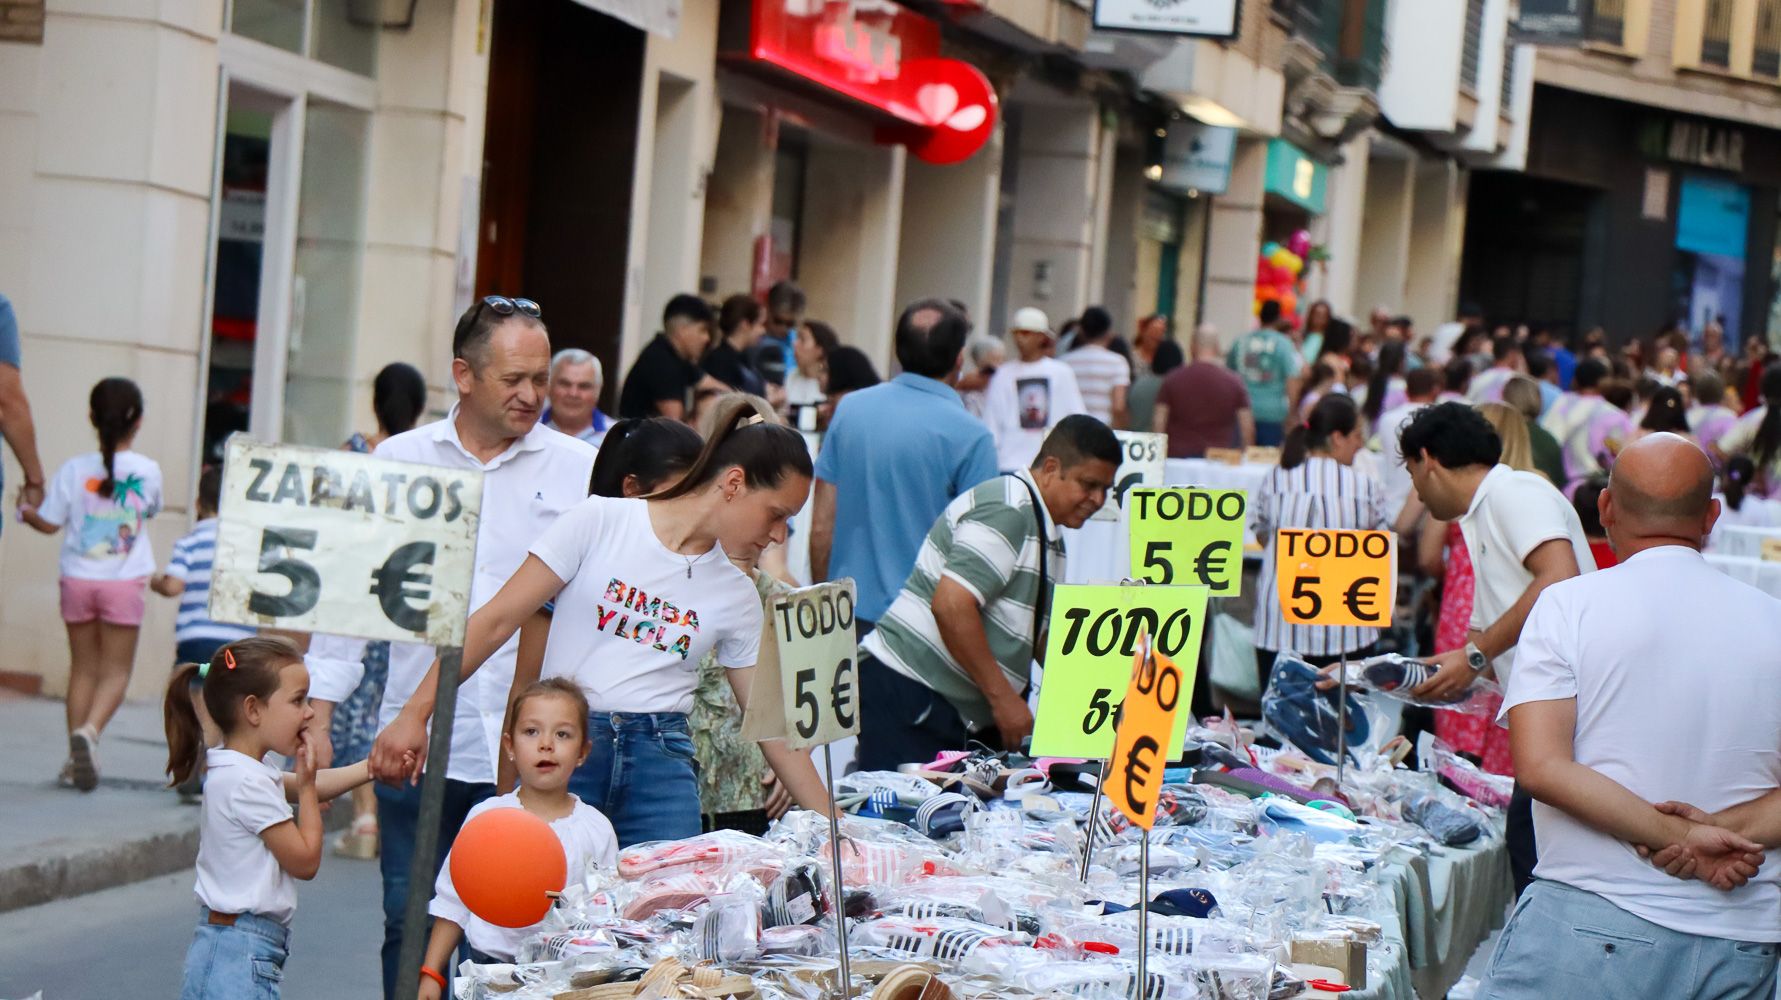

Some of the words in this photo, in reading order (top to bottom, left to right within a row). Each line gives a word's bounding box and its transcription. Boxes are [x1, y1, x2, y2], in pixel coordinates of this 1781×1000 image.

[245, 458, 465, 523] ZAPATOS
[1133, 491, 1245, 521] TODO
[1142, 541, 1174, 585] 5
[1193, 540, 1232, 591] €
[1280, 531, 1390, 559] TODO
[249, 525, 322, 618] 5
[369, 541, 437, 632] €
[1291, 576, 1322, 620] 5
[1342, 576, 1380, 622] €
[603, 577, 700, 633] BIMBA
[775, 590, 853, 642] TODO
[1061, 607, 1191, 657] TODO
[795, 668, 820, 739] 5
[830, 658, 855, 729] €
[1125, 735, 1160, 815] €
